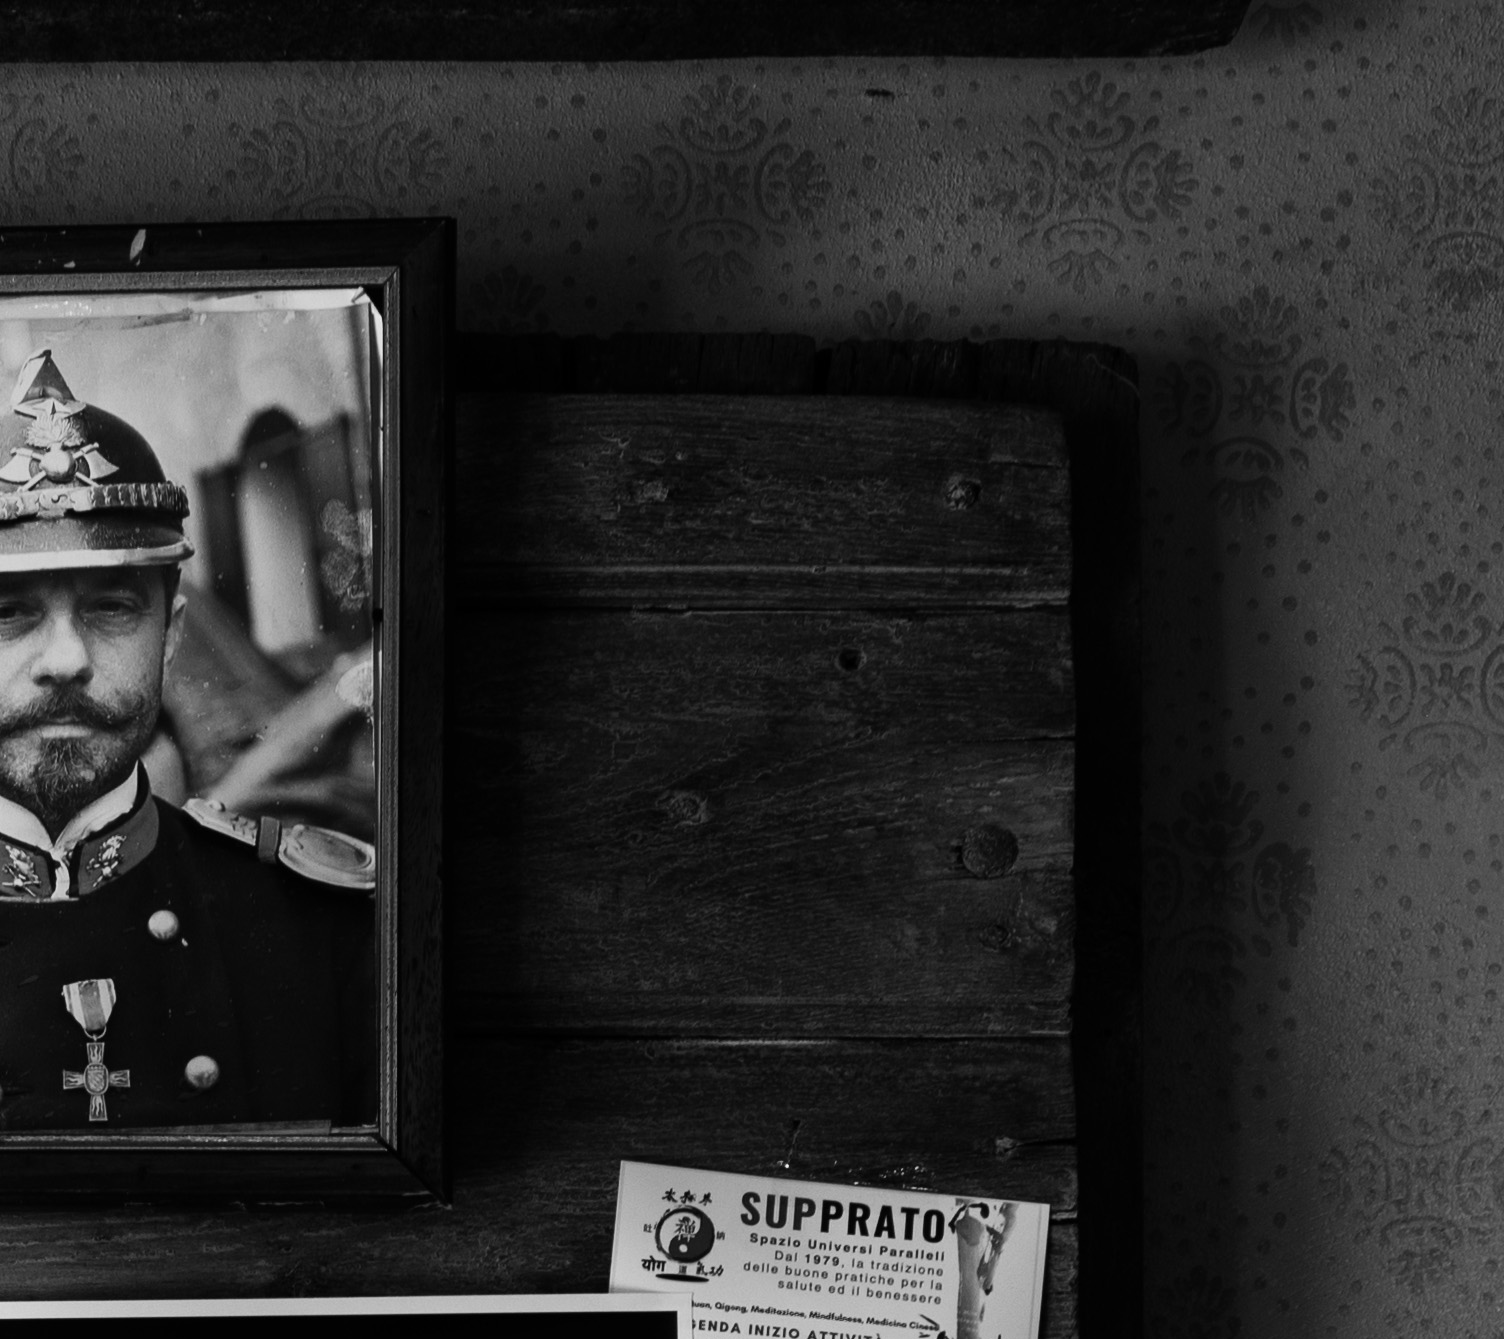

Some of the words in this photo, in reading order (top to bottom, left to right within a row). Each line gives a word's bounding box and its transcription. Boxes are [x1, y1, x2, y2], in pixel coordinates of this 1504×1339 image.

[740, 1191, 945, 1244] SUPPRATO
[749, 1232, 801, 1248] Spazio
[807, 1238, 873, 1255] Universi
[879, 1245, 945, 1262] Paralleli
[743, 1261, 779, 1275] delle
[784, 1265, 829, 1280] buone
[834, 1272, 895, 1286] pratiche
[900, 1278, 924, 1289] per
[930, 1279, 943, 1291] la
[774, 1249, 798, 1263] Dal
[804, 1253, 845, 1269] 1979,
[851, 1258, 864, 1269] la
[870, 1260, 944, 1277] tradizione
[777, 1280, 822, 1293] salute
[828, 1284, 845, 1295] ed
[851, 1286, 860, 1297] il
[866, 1287, 942, 1305] benessere
[748, 1323, 800, 1339] INIZIO
